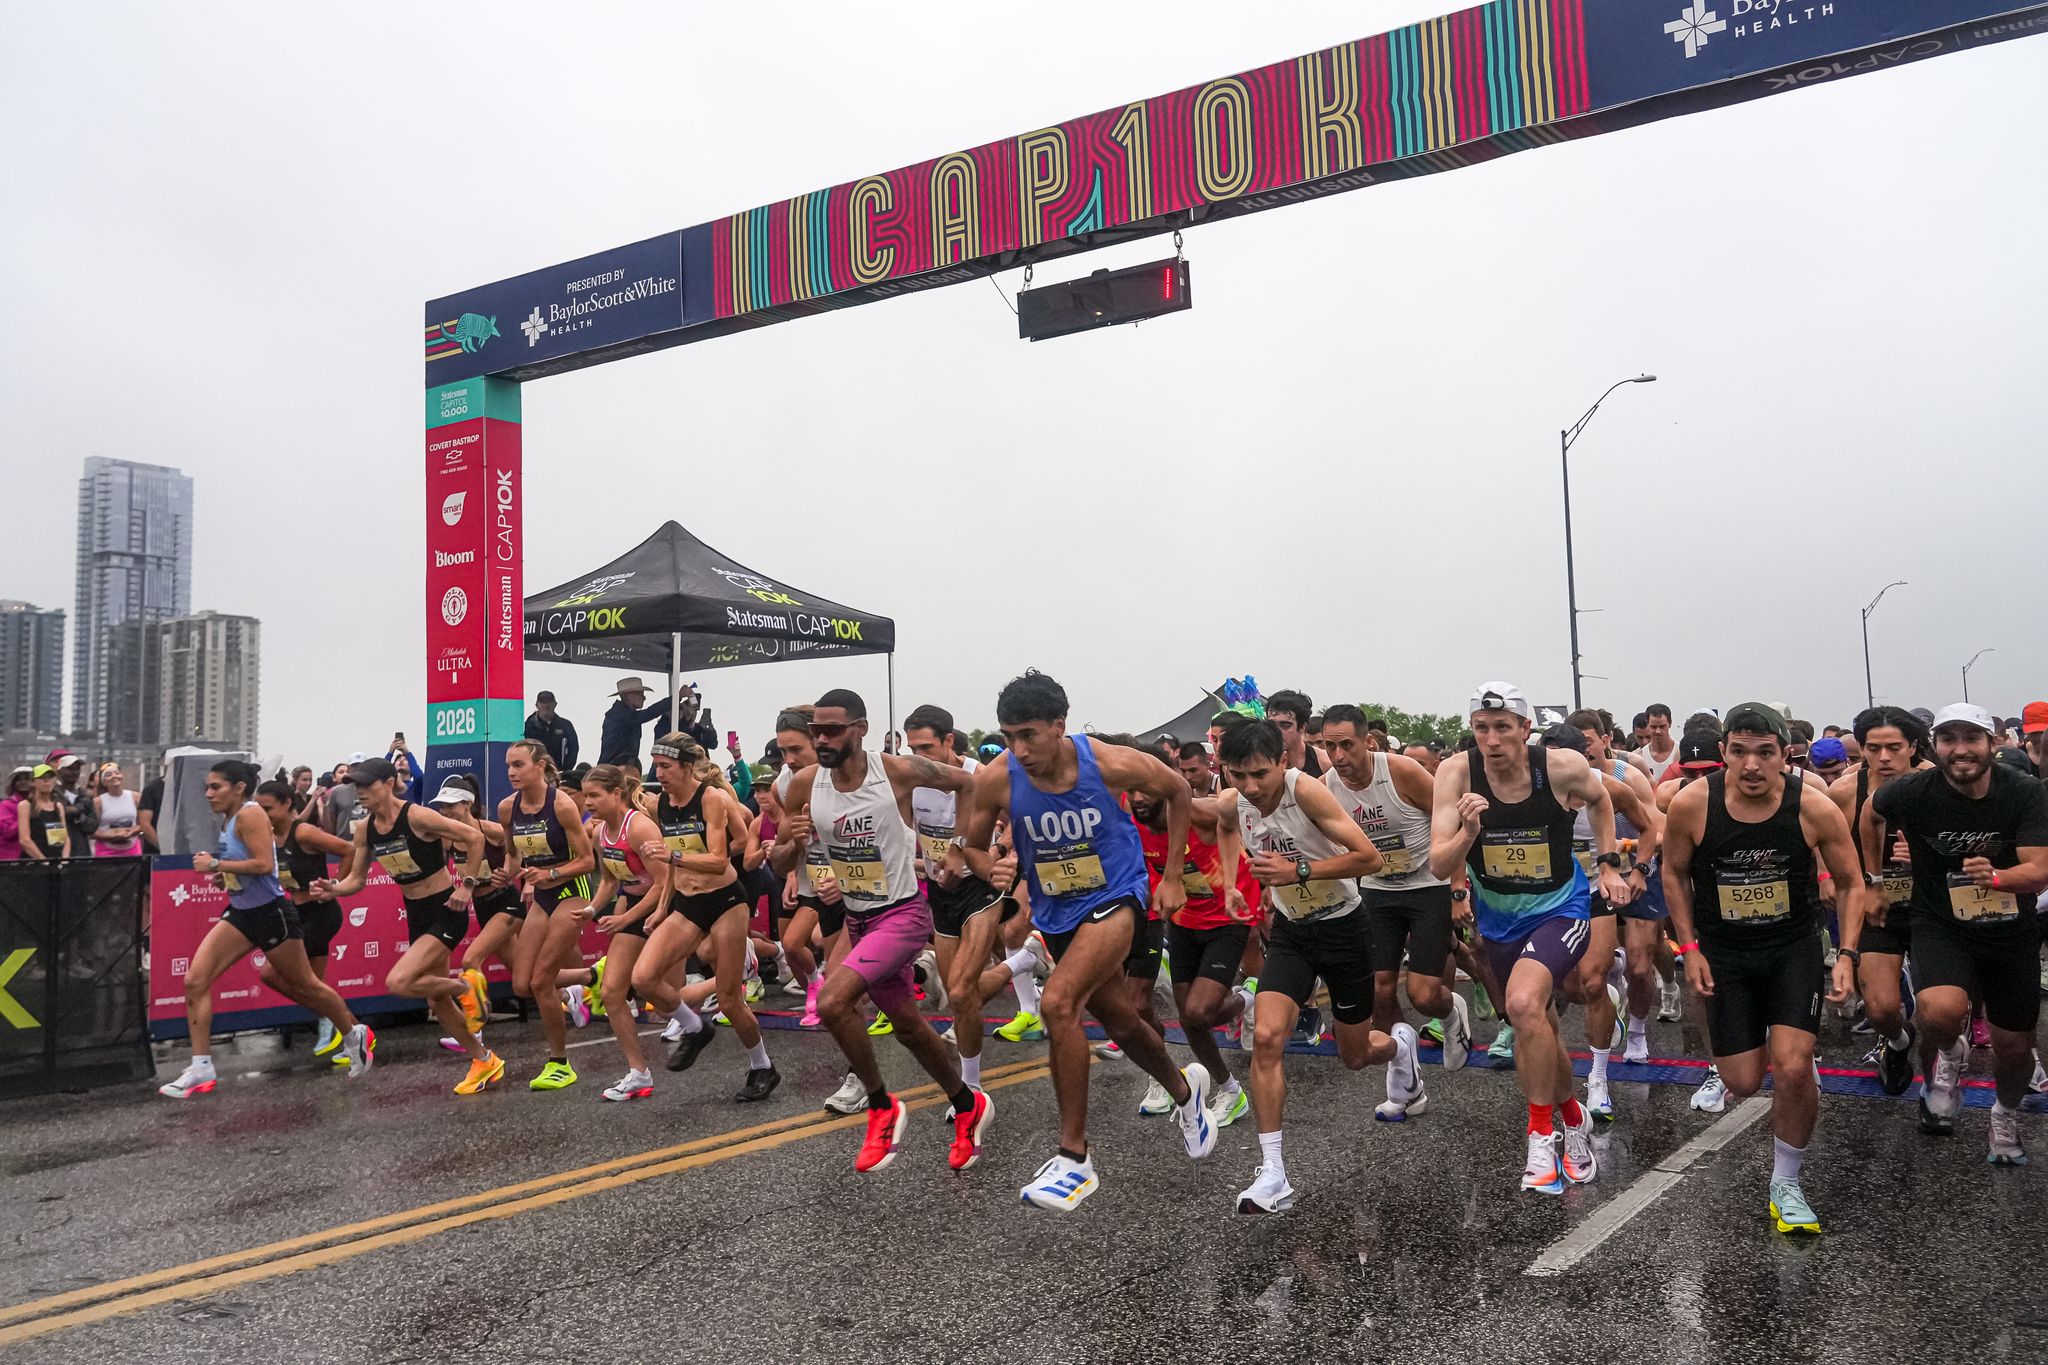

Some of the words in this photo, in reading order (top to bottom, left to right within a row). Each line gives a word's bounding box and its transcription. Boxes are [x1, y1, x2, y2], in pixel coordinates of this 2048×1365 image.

[1735, 3, 1834, 38] HEALTH
[1763, 40, 1943, 90] CAP10K
[566, 272, 612, 294] PRESENTED
[614, 268, 625, 281] BY
[550, 319, 593, 337] HEALTH
[440, 405, 468, 418] 10,000
[429, 441, 452, 452] COVERT
[452, 434, 480, 447] BASTROP
[443, 504, 462, 514] smart
[496, 468, 514, 561] CAP10K
[436, 551, 475, 568] Bloom
[746, 589, 803, 606] 10K
[498, 575, 513, 651] Statesman
[547, 606, 627, 635] CAP10K
[726, 606, 787, 630] Statesman
[796, 614, 863, 641] CAP10K
[437, 656, 472, 671] ULTRA
[436, 707, 475, 736] 2026
[437, 758, 473, 769] BENEFITING
[1023, 807, 1102, 843] LOOP
[1367, 821, 1390, 833] ONE
[1512, 830, 1541, 838] CAP10K
[1938, 831, 2001, 844] FLIGHT
[526, 836, 533, 846] 8
[679, 837, 686, 848] 9
[849, 836, 875, 848] ONE
[932, 840, 945, 851] 23
[1505, 848, 1526, 861] 29
[816, 867, 829, 879] 27
[846, 865, 865, 878] 20
[1060, 862, 1077, 876] 16
[1491, 865, 1497, 873] 1
[1749, 869, 1779, 877] CAP10K
[840, 879, 845, 888] 1
[1046, 882, 1053, 892] 1
[1884, 879, 1912, 891] 526
[1732, 886, 1775, 902] 5268
[1974, 888, 1988, 900] 17
[1728, 909, 1734, 919] 1
[1958, 909, 1965, 917] 1
